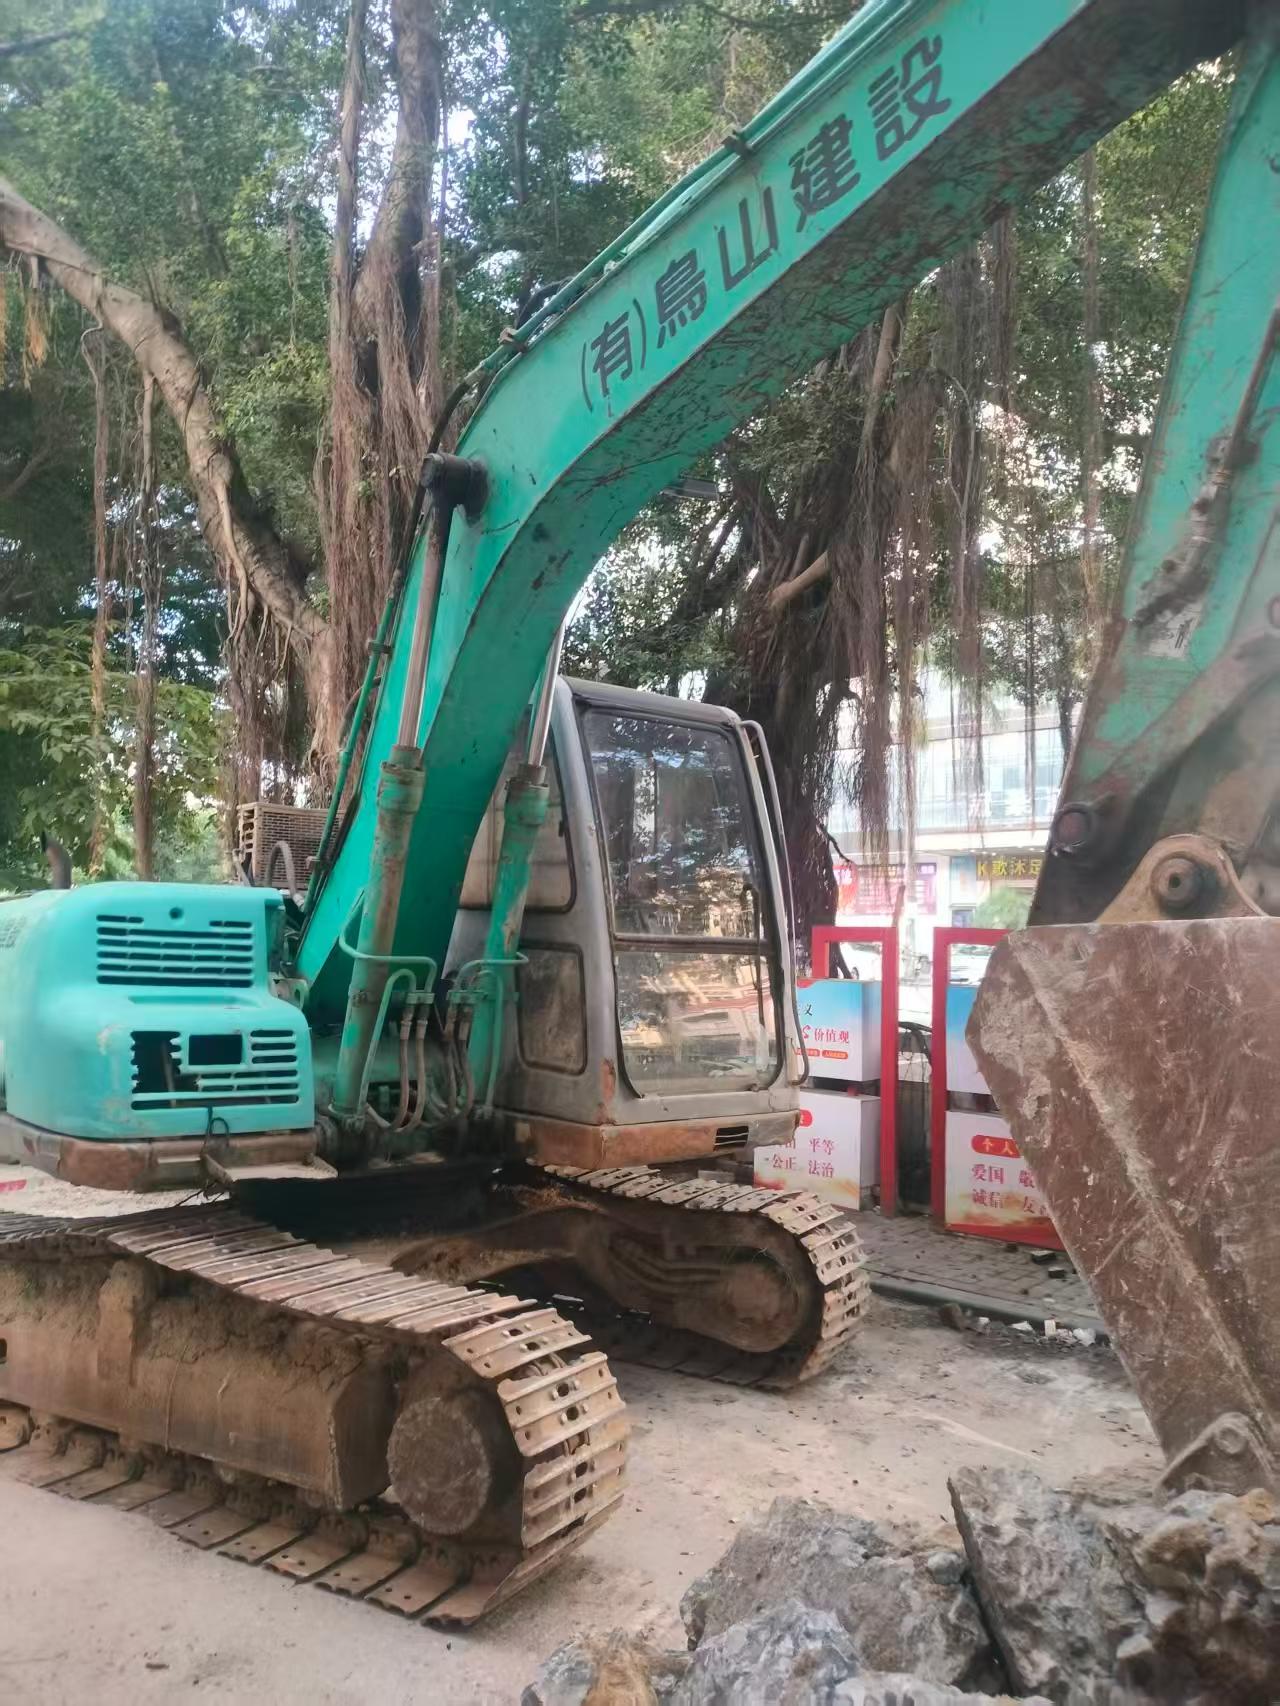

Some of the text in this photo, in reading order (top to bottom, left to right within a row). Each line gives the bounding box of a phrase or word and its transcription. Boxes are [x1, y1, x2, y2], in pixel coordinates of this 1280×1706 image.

[810, 1137, 835, 1155] 平等
[773, 1154, 834, 1178] 公正 法治
[972, 1164, 1004, 1184] 爱国
[972, 1189, 1004, 1208] 诚信
